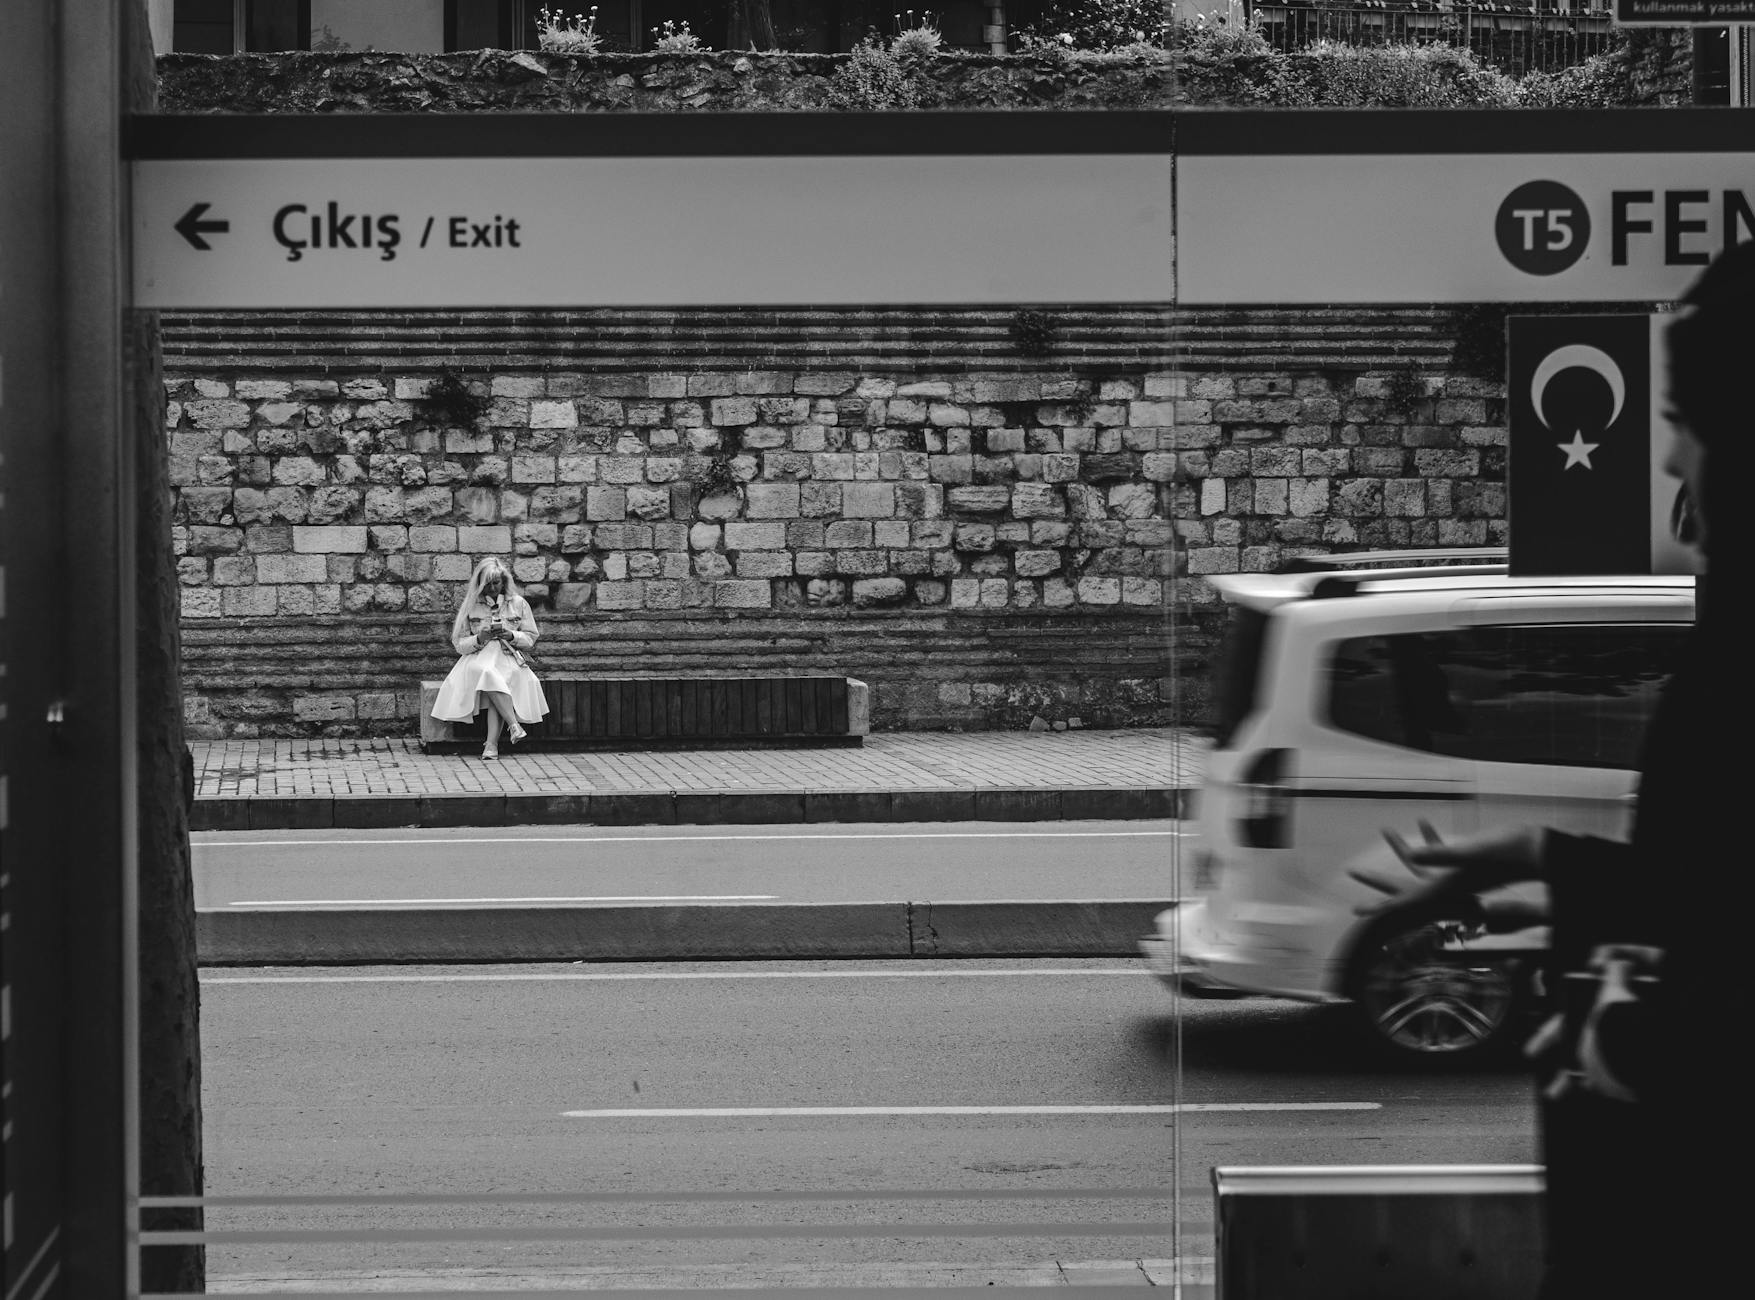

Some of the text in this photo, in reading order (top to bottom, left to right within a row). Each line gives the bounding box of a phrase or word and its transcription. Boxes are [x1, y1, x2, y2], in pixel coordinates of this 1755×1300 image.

[1633, 1, 1704, 13] kullanmak
[273, 202, 520, 261] Çıkış / Exit
[1512, 209, 1573, 250] T5
